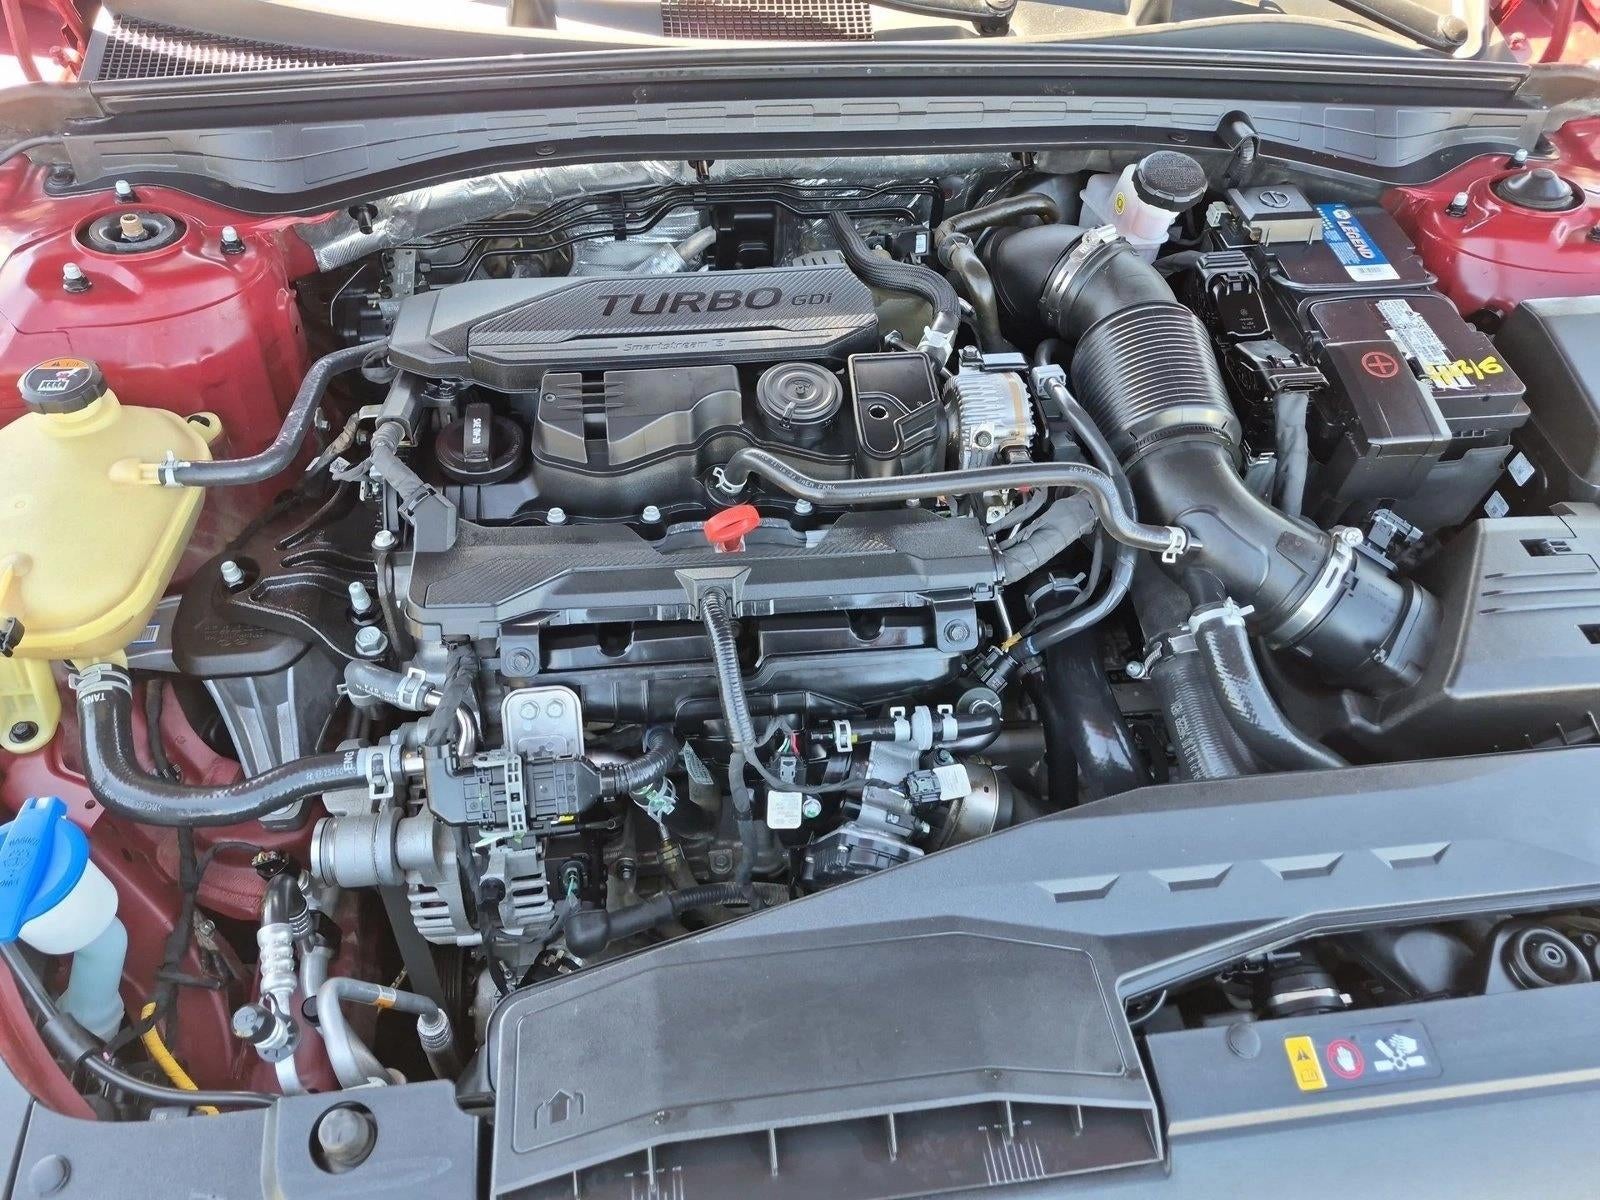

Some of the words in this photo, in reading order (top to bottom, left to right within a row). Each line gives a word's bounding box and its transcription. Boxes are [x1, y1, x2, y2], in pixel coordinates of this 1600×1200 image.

[1336, 220, 1376, 259] LEGEND
[597, 286, 783, 316] TURBO
[792, 292, 832, 306] GDi
[623, 339, 708, 352] Smartstream
[82, 692, 106, 705] TANK
